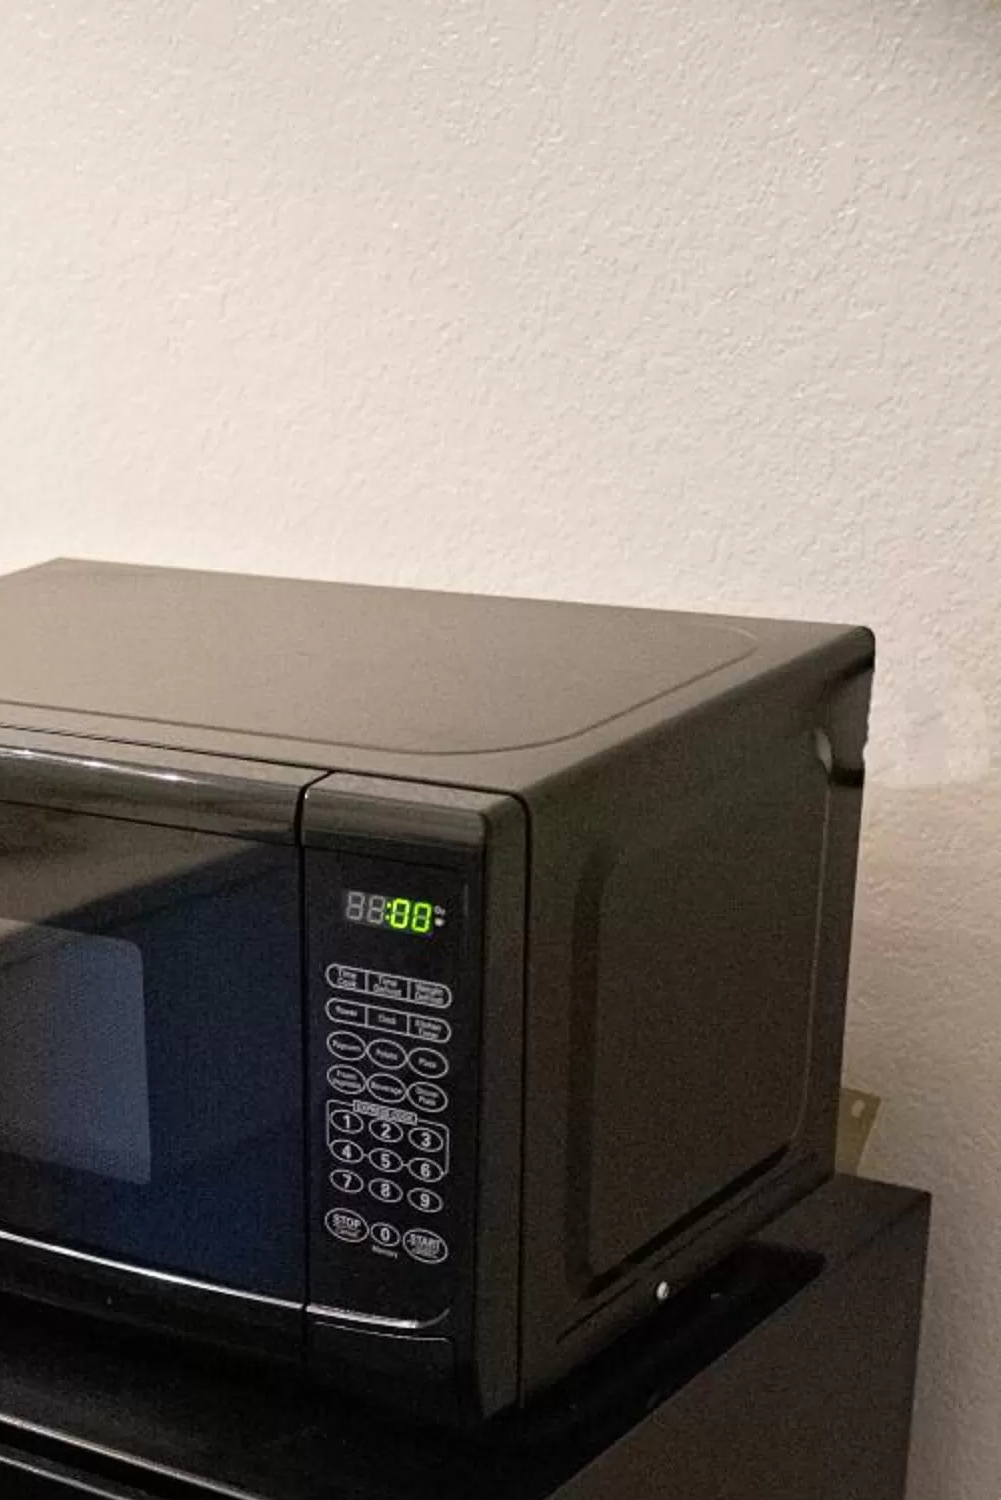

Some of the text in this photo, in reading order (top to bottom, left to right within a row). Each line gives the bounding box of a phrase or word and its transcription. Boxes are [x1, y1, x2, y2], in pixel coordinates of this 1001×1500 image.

[342, 1114, 432, 1147] 1 2 3
[342, 1144, 431, 1178] 4 5 6
[342, 1173, 430, 1208] 7 8 9
[333, 1212, 362, 1231] STOP
[380, 1227, 391, 1242] 0
[407, 1234, 441, 1253] START
